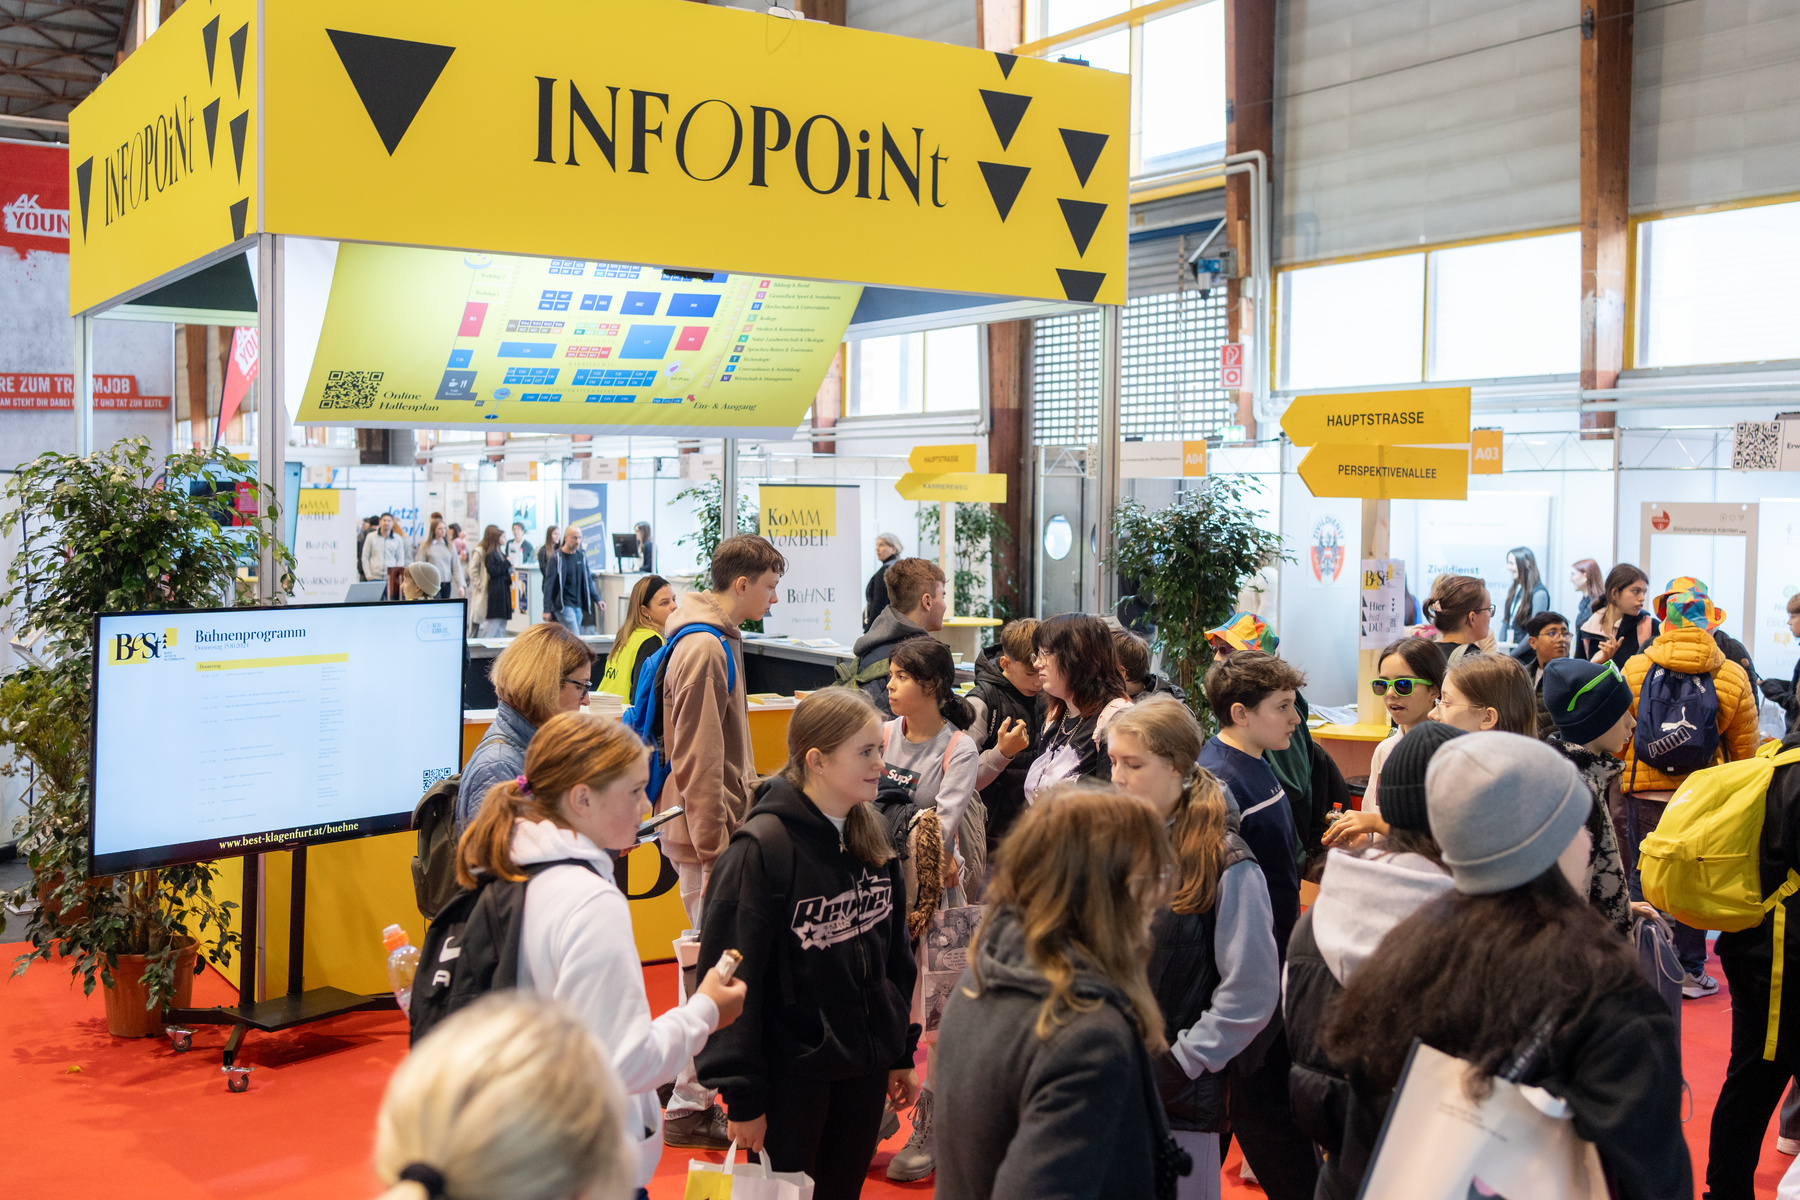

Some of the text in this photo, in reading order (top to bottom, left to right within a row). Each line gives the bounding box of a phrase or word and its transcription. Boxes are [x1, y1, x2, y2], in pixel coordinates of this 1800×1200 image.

[533, 75, 949, 208] INFOPOiNt
[105, 95, 194, 227] INFOPOiNt
[12, 193, 41, 209] AK
[19, 376, 50, 393] ZUM
[54, 377, 130, 394] TRMJOB
[383, 391, 422, 400] Online
[12, 398, 35, 407] STEHT
[36, 398, 48, 407] DIR
[50, 398, 70, 407] DABEI
[100, 399, 115, 407] UND
[116, 399, 128, 407] TAT
[379, 402, 440, 412] Hallenplan
[712, 402, 719, 410] &
[720, 402, 757, 412] Ausgang
[1327, 411, 1425, 426] HAUPTSTRASSE
[924, 455, 959, 464] HAUPTSTRASSE
[1185, 453, 1203, 465] A04
[1474, 446, 1499, 461] A03
[1338, 464, 1437, 479] PERSPEKTIVENALLEE
[923, 483, 969, 491] KARRIEREWEG
[1312, 516, 1345, 540] ZIVILDIENST
[1673, 526, 1717, 534] Bildungsberatung
[1427, 565, 1479, 575] Zivildienst
[1369, 602, 1386, 611] Hier
[1368, 622, 1383, 633] DU!
[194, 628, 307, 644] Bühnenprogramm
[1648, 726, 1692, 759] PUMA
[887, 769, 913, 786] Sup?
[219, 822, 359, 850] www.best-klagenfurt.at/buehne
